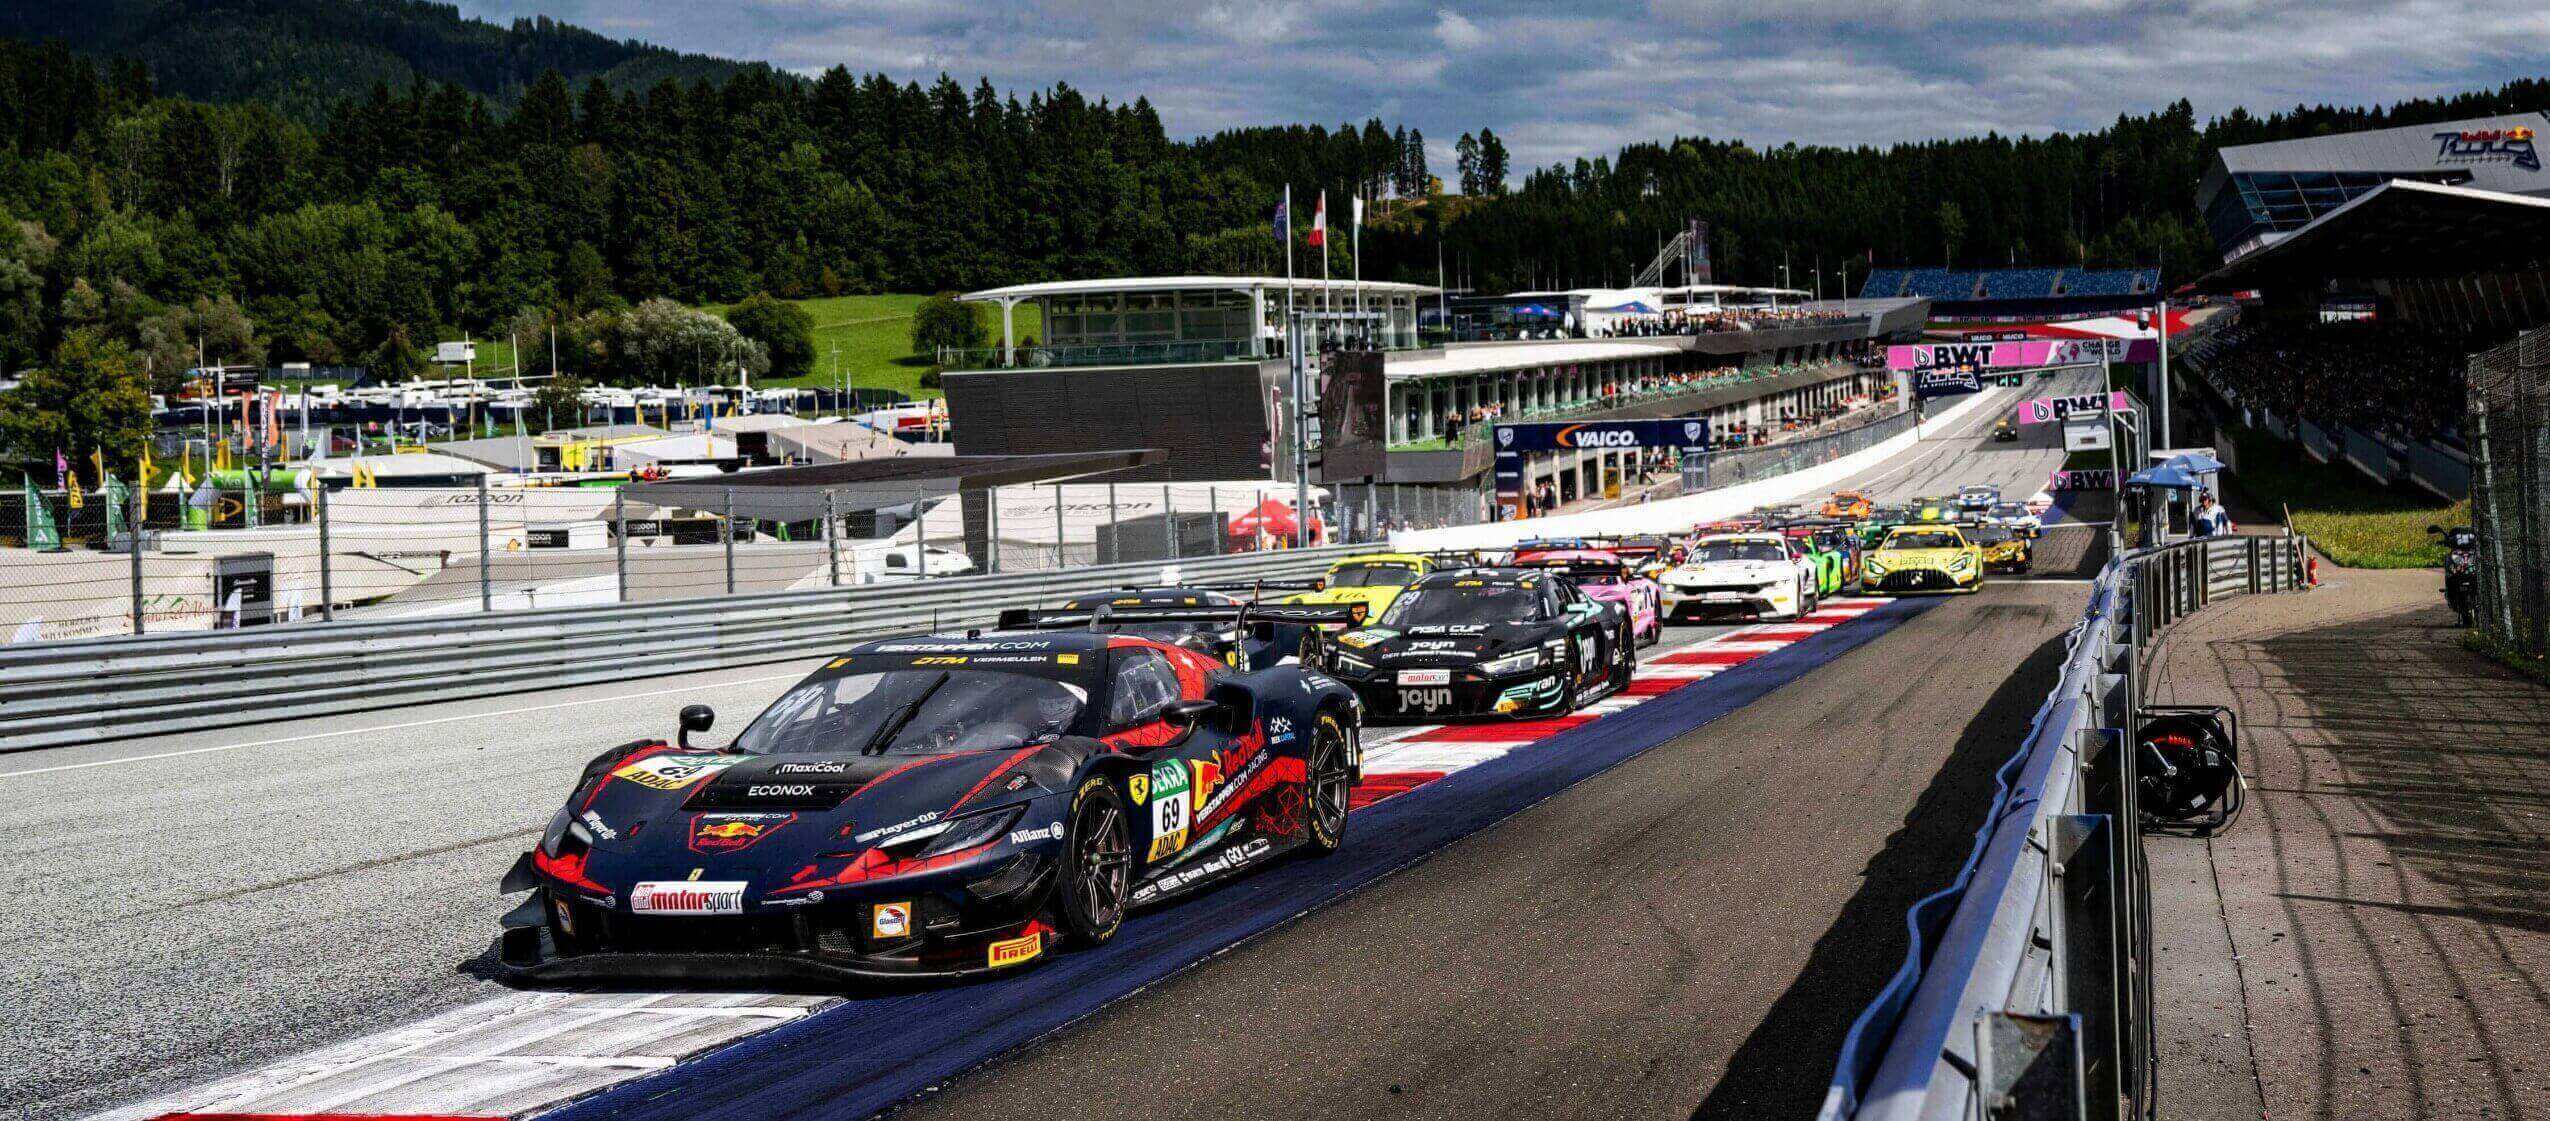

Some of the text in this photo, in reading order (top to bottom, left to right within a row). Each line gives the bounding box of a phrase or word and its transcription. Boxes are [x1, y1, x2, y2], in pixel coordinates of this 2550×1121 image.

[1934, 344, 1993, 368] BWT
[1449, 623, 1490, 632] CUP
[1408, 641, 1456, 651] joyn
[1536, 675, 1556, 691] ran
[1398, 688, 1452, 712] joyn
[625, 770, 682, 789] ADAC
[748, 785, 816, 797] ECONOX
[1162, 797, 1181, 833] 69
[870, 819, 918, 839] Player
[1011, 830, 1051, 844] Allianz
[1155, 831, 1181, 858] ADAC
[651, 889, 742, 912] motorsport
[993, 938, 1039, 961] PIRELLI
